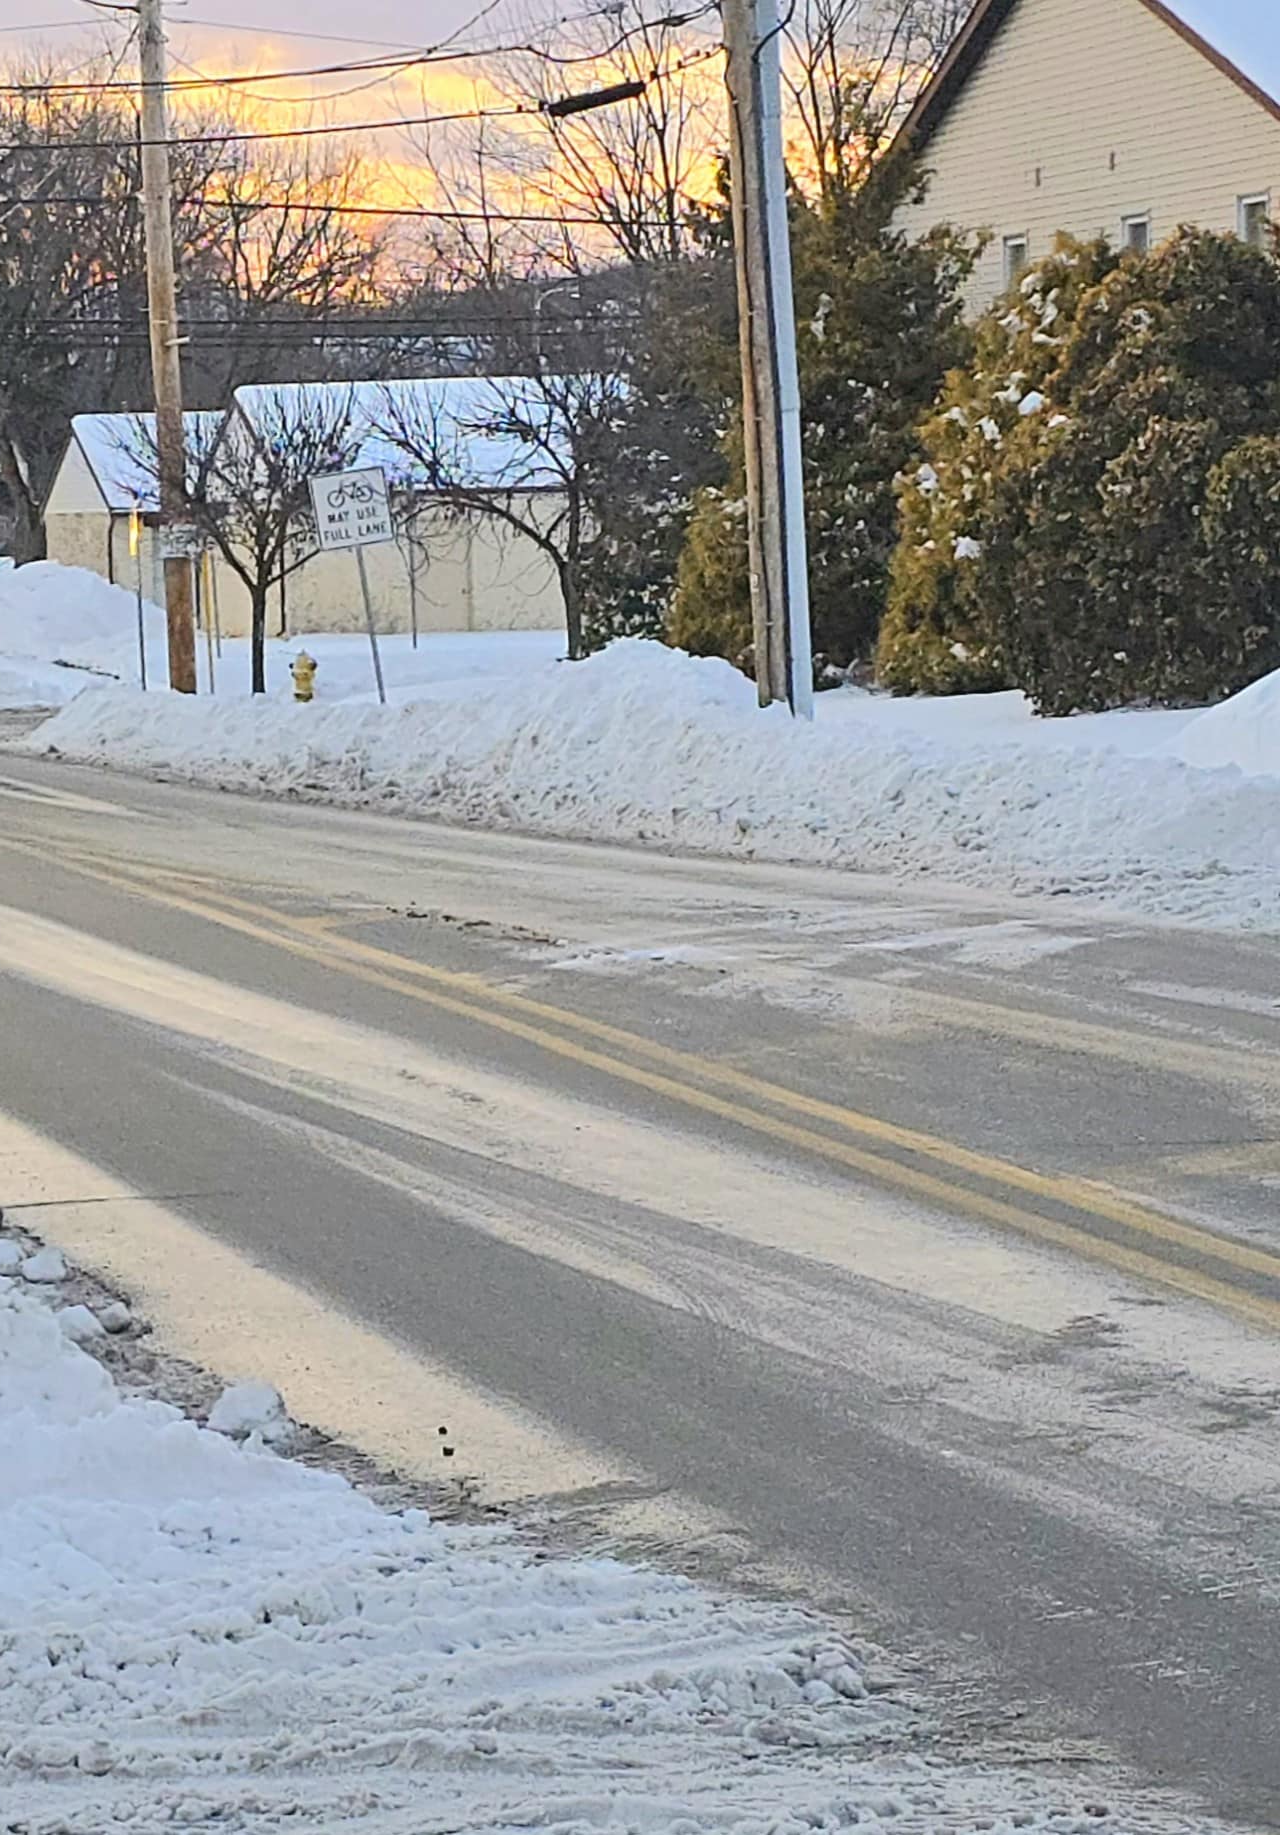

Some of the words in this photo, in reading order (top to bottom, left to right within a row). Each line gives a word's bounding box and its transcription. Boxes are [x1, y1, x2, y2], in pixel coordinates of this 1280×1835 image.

[328, 511, 350, 523] MAY
[356, 506, 377, 520] USE
[324, 528, 352, 541] FULL
[358, 521, 387, 536] LANE
